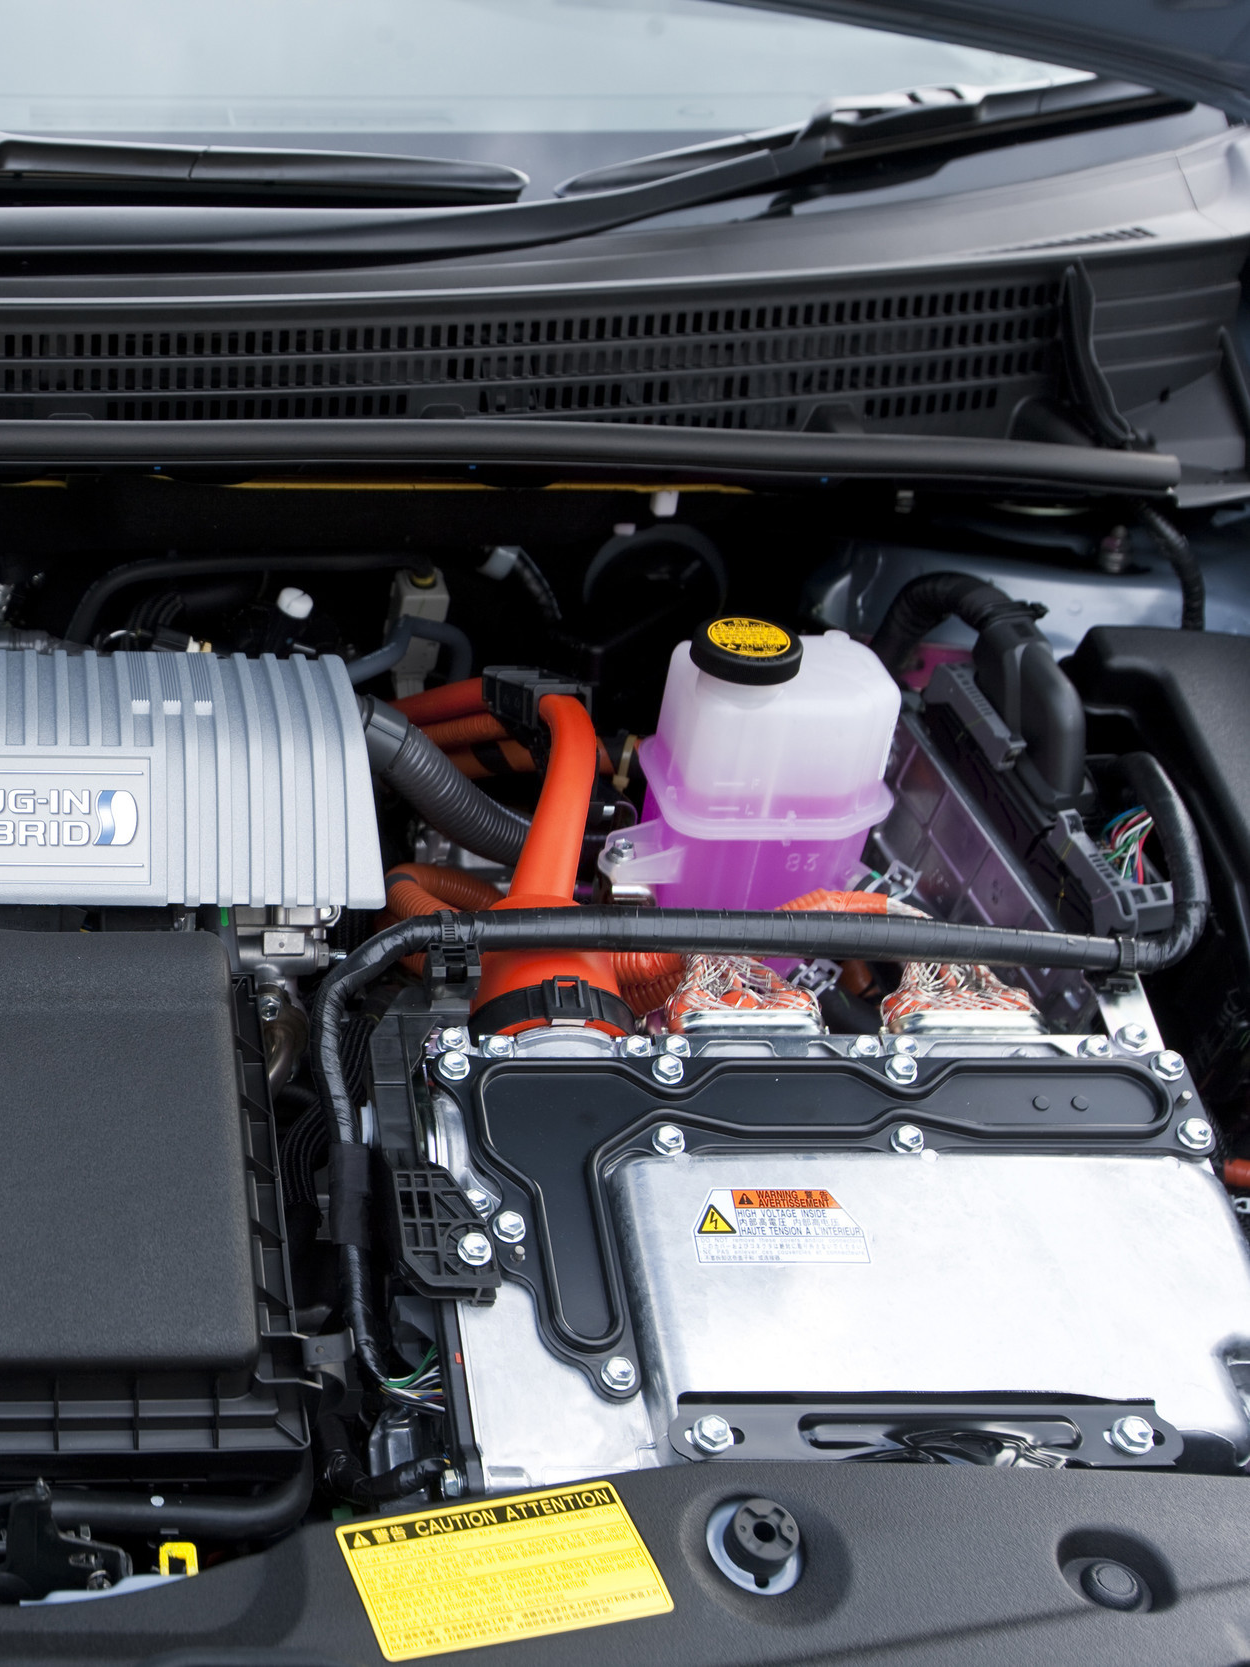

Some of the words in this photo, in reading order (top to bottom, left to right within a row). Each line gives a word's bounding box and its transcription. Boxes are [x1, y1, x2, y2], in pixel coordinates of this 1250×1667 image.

[785, 853, 820, 872] 83
[755, 1190, 798, 1199] WARNING
[758, 1199, 830, 1208] AVERTISSEMENT
[737, 1209, 757, 1217] HIGH
[761, 1209, 797, 1218] VOLTAGE
[801, 1209, 827, 1218] INSIDE
[741, 1227, 766, 1235] HAUTE
[769, 1227, 803, 1235] TENSION
[414, 1509, 498, 1537] CAUTION
[505, 1489, 612, 1522] ATTENTION
